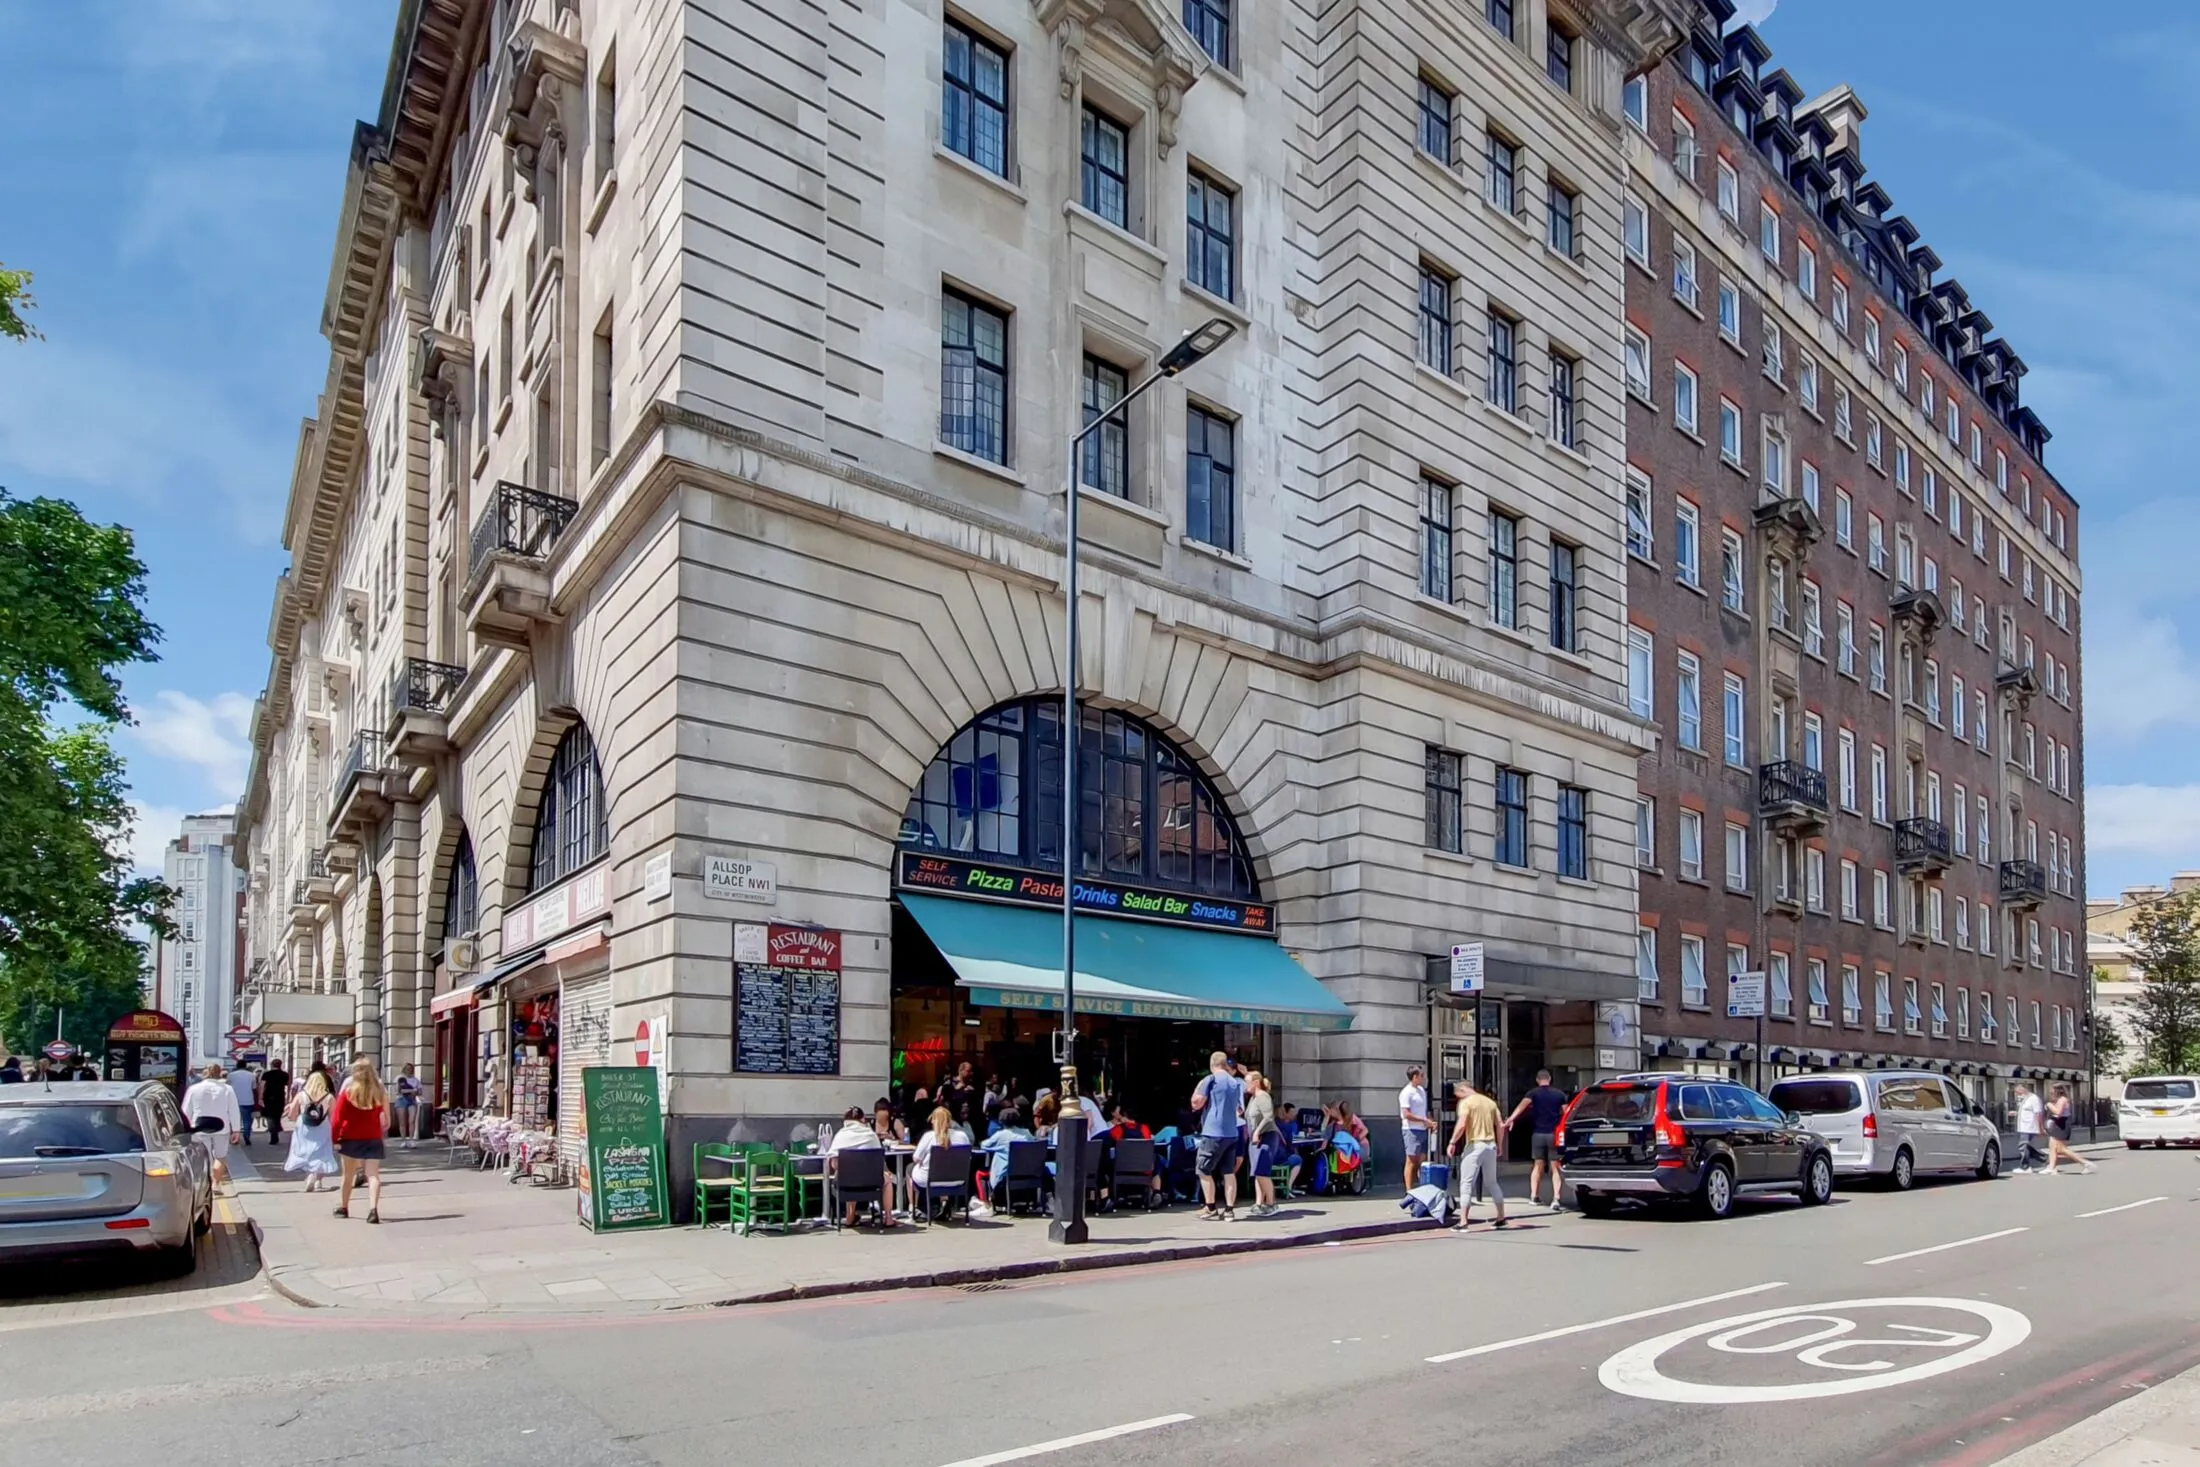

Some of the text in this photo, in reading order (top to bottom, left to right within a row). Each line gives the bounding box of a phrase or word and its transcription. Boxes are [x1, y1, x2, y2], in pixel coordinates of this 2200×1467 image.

[712, 861, 752, 875] ALLSOP
[919, 859, 949, 871] SELF
[712, 873, 770, 890] PLACE NW1
[908, 870, 959, 887] SERVICE
[967, 869, 1237, 921] Pizza Pasta Drinks Salad Bar Snacks
[1244, 906, 1265, 916] TAKE
[1243, 917, 1266, 928] AWAY
[770, 931, 837, 955] RESTAURANT
[776, 954, 827, 966] COFFEE BAR
[1000, 992, 1043, 1006] SELF
[1052, 997, 1123, 1013] SRVICE
[1132, 1001, 1233, 1020] RESTAURANT
[593, 1090, 653, 1111] RESTAURANT
